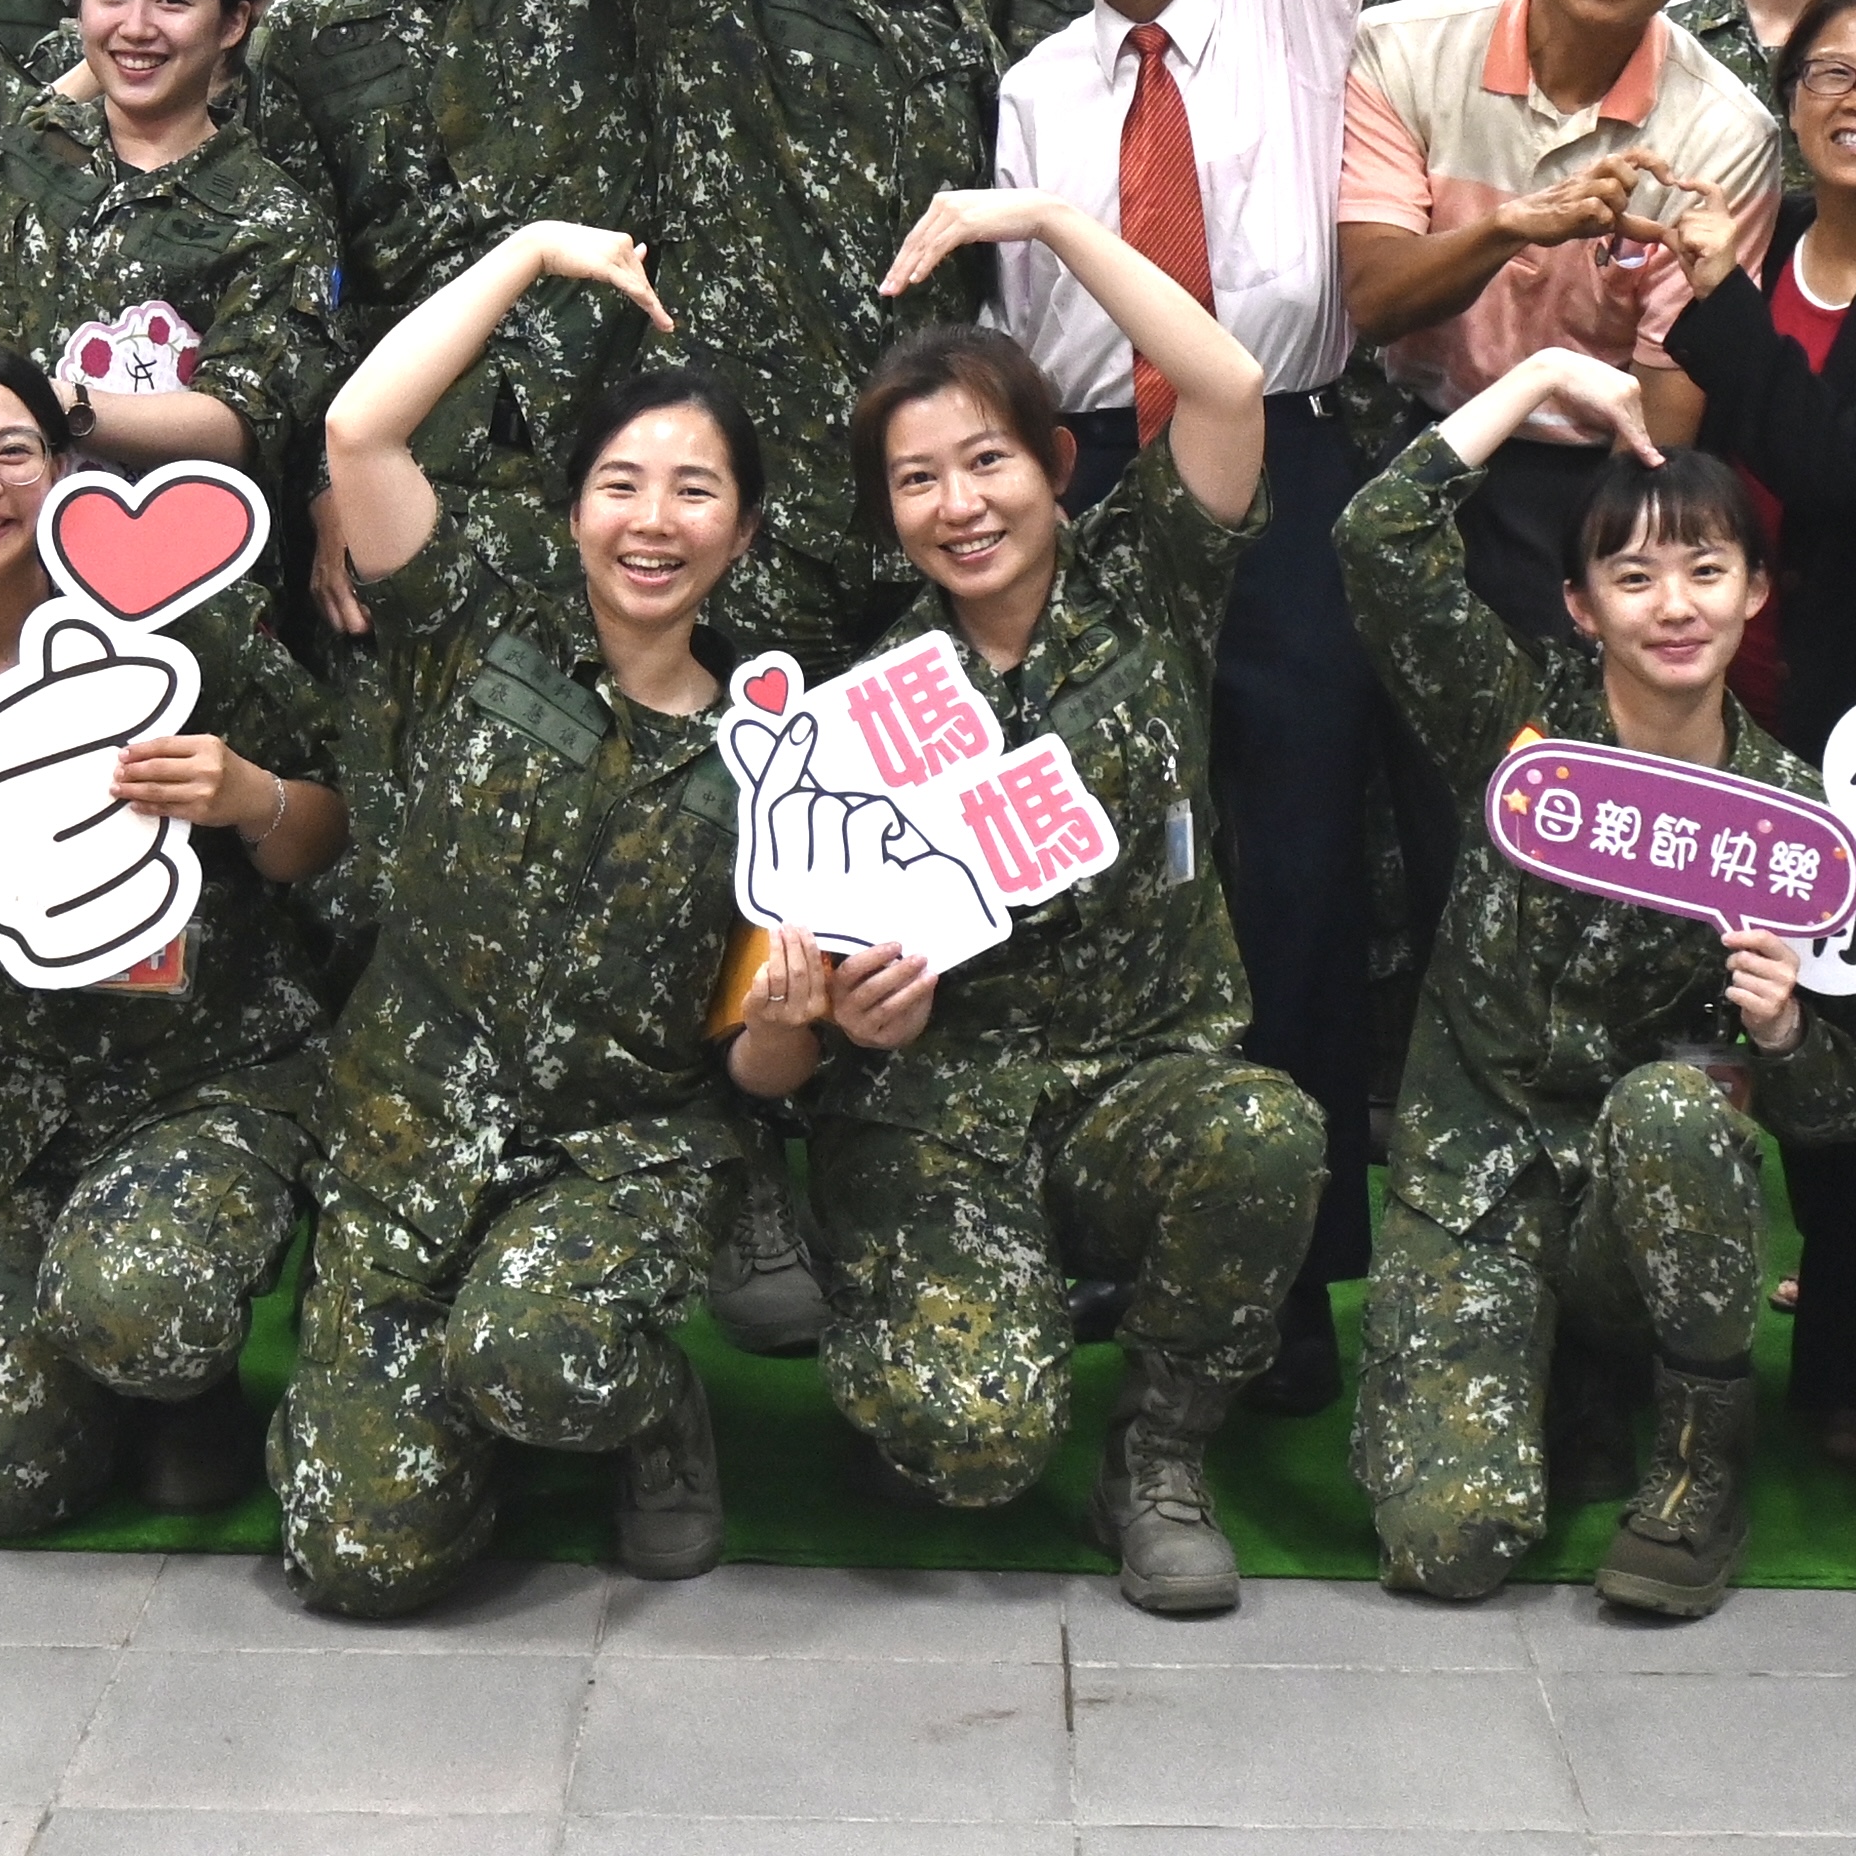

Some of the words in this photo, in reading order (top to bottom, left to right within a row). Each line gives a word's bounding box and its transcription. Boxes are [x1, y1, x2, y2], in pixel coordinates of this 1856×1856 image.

[846, 646, 1105, 895] 媽媽
[1534, 787, 1821, 903] 母親節快樂
